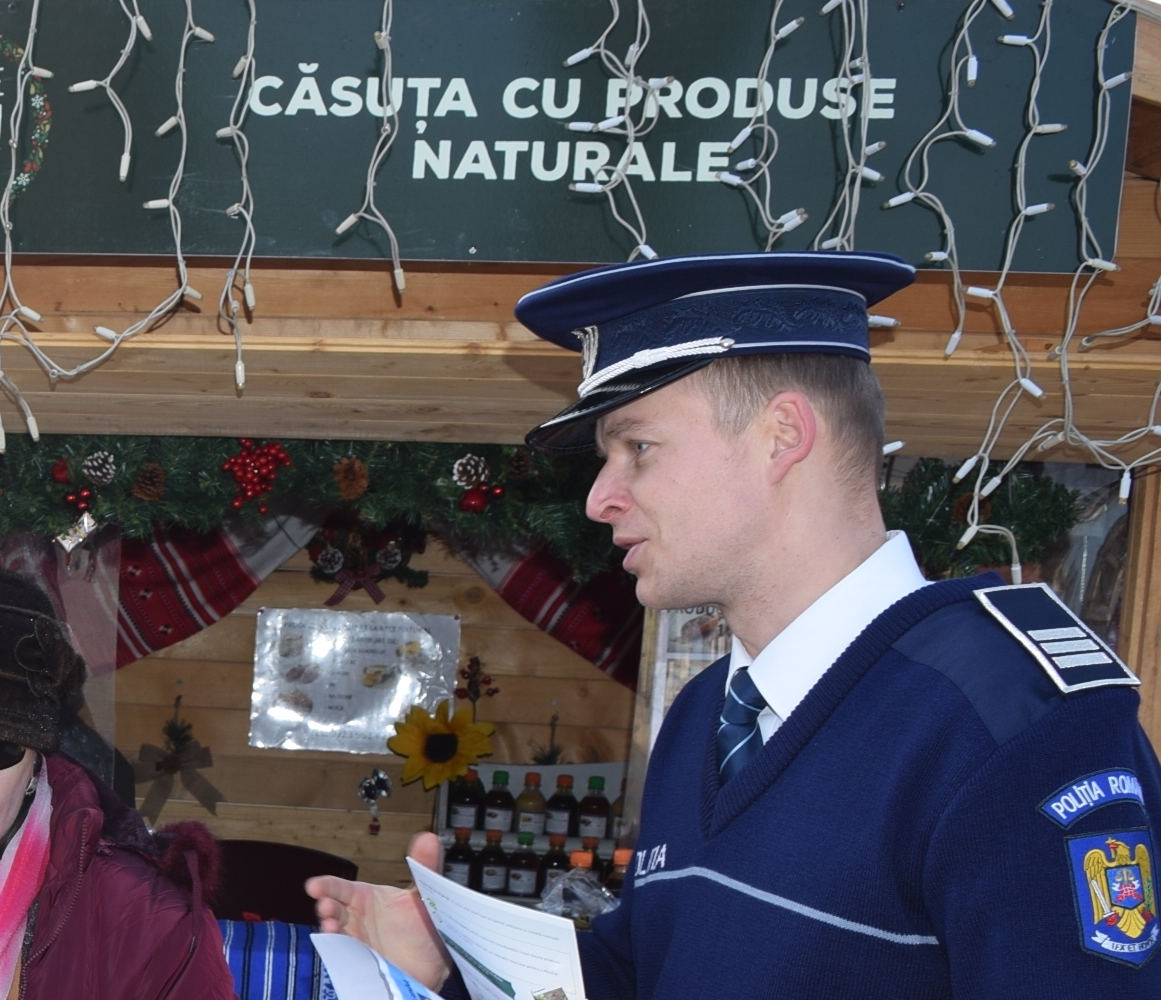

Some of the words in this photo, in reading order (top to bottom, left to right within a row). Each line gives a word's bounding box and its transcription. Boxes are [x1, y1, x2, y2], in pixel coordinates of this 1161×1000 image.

[502, 77, 581, 119] CU
[605, 77, 897, 119] PRODUSE
[412, 139, 731, 183] NATURALE
